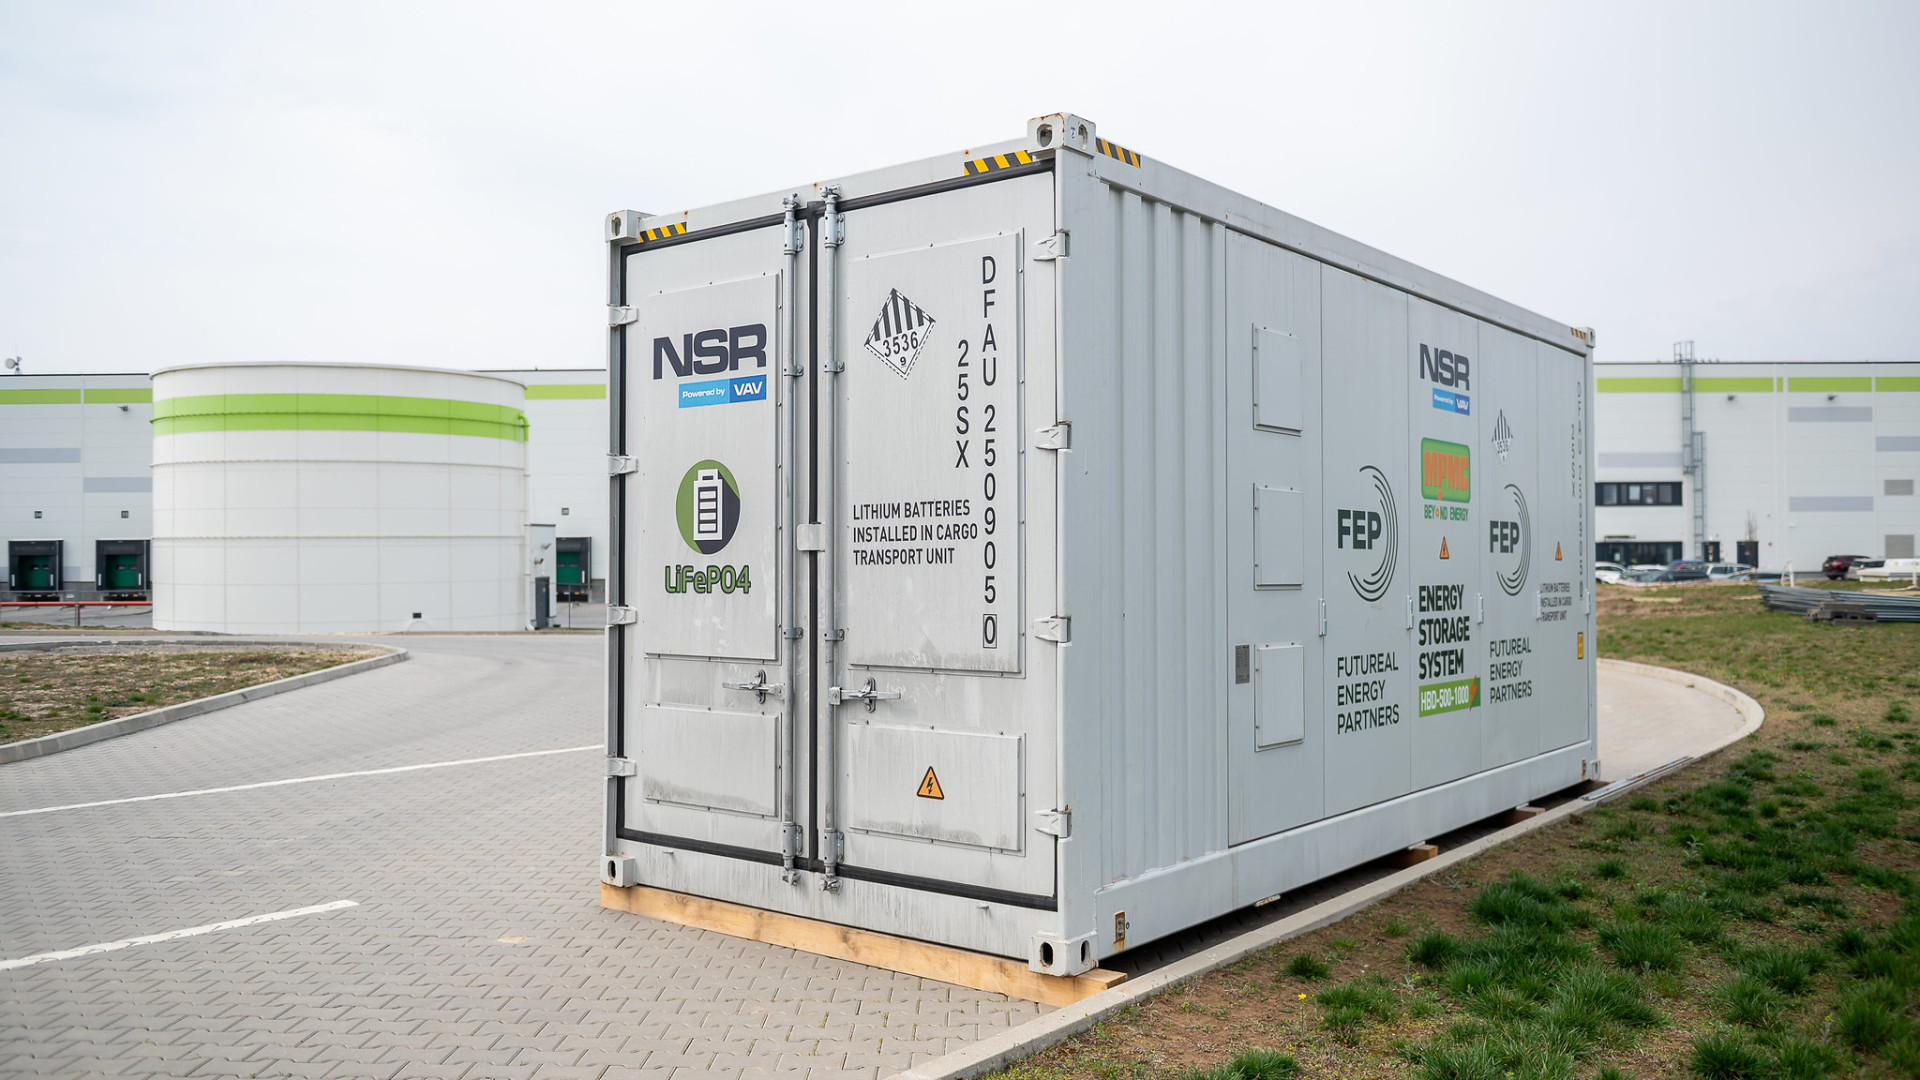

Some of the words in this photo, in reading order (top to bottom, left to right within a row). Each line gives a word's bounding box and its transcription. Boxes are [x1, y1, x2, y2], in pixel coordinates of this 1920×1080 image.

[983, 256, 997, 386] DFAU
[654, 324, 767, 379] NSR
[883, 331, 919, 358] 3536
[900, 356, 907, 366] 9
[1420, 343, 1470, 391] NSR
[682, 388, 715, 399] Powered
[715, 387, 726, 397] by
[734, 382, 763, 396] VAV
[955, 340, 970, 468] 25SX
[1456, 398, 1469, 410] VAV
[1424, 451, 1469, 491] MPMC
[853, 503, 901, 521] LITHIUM
[904, 500, 970, 519] BATTERIES
[984, 405, 996, 603] 250905
[1450, 506, 1469, 521] ENERGY
[853, 525, 917, 543] INSTALLED
[920, 524, 933, 541] IN
[936, 522, 978, 540] CARGO
[1338, 509, 1382, 550] FEP
[1490, 521, 1520, 553] FEP
[853, 549, 922, 566] TRANSPORT
[926, 547, 955, 564] UNIT
[1419, 585, 1464, 613] ENERGY
[1419, 616, 1470, 647] STORAGE
[1490, 637, 1532, 658] FUTUREAL
[1338, 651, 1399, 678] FUTUREAL
[1419, 649, 1464, 680] SYSTEM
[1490, 660, 1523, 681] ENERGY
[1338, 680, 1386, 706] ENERGY
[1420, 685, 1469, 711] HBD-500-1000
[1490, 683, 1532, 704] PARTNERS
[1338, 703, 1400, 735] PARTNERS
